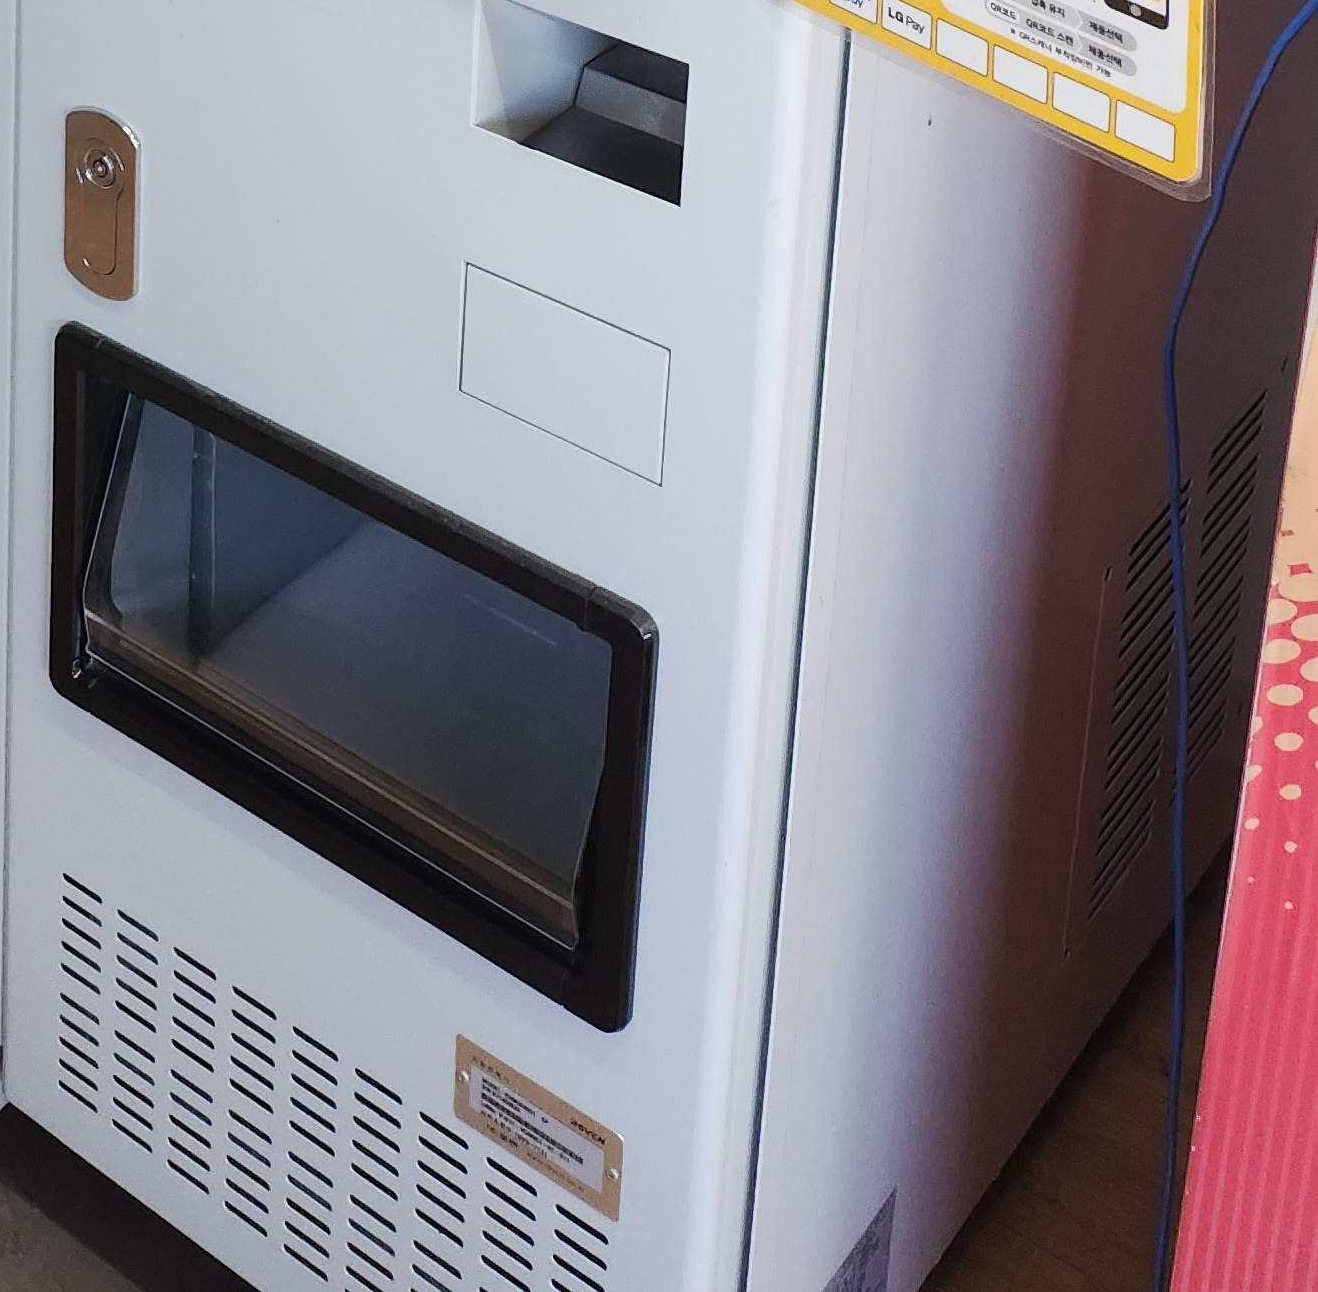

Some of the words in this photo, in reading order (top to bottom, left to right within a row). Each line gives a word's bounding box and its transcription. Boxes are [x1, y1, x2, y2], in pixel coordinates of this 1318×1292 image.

[888, 7, 904, 23] LG
[906, 15, 925, 34] Pay
[1049, 4, 1066, 18] 유지
